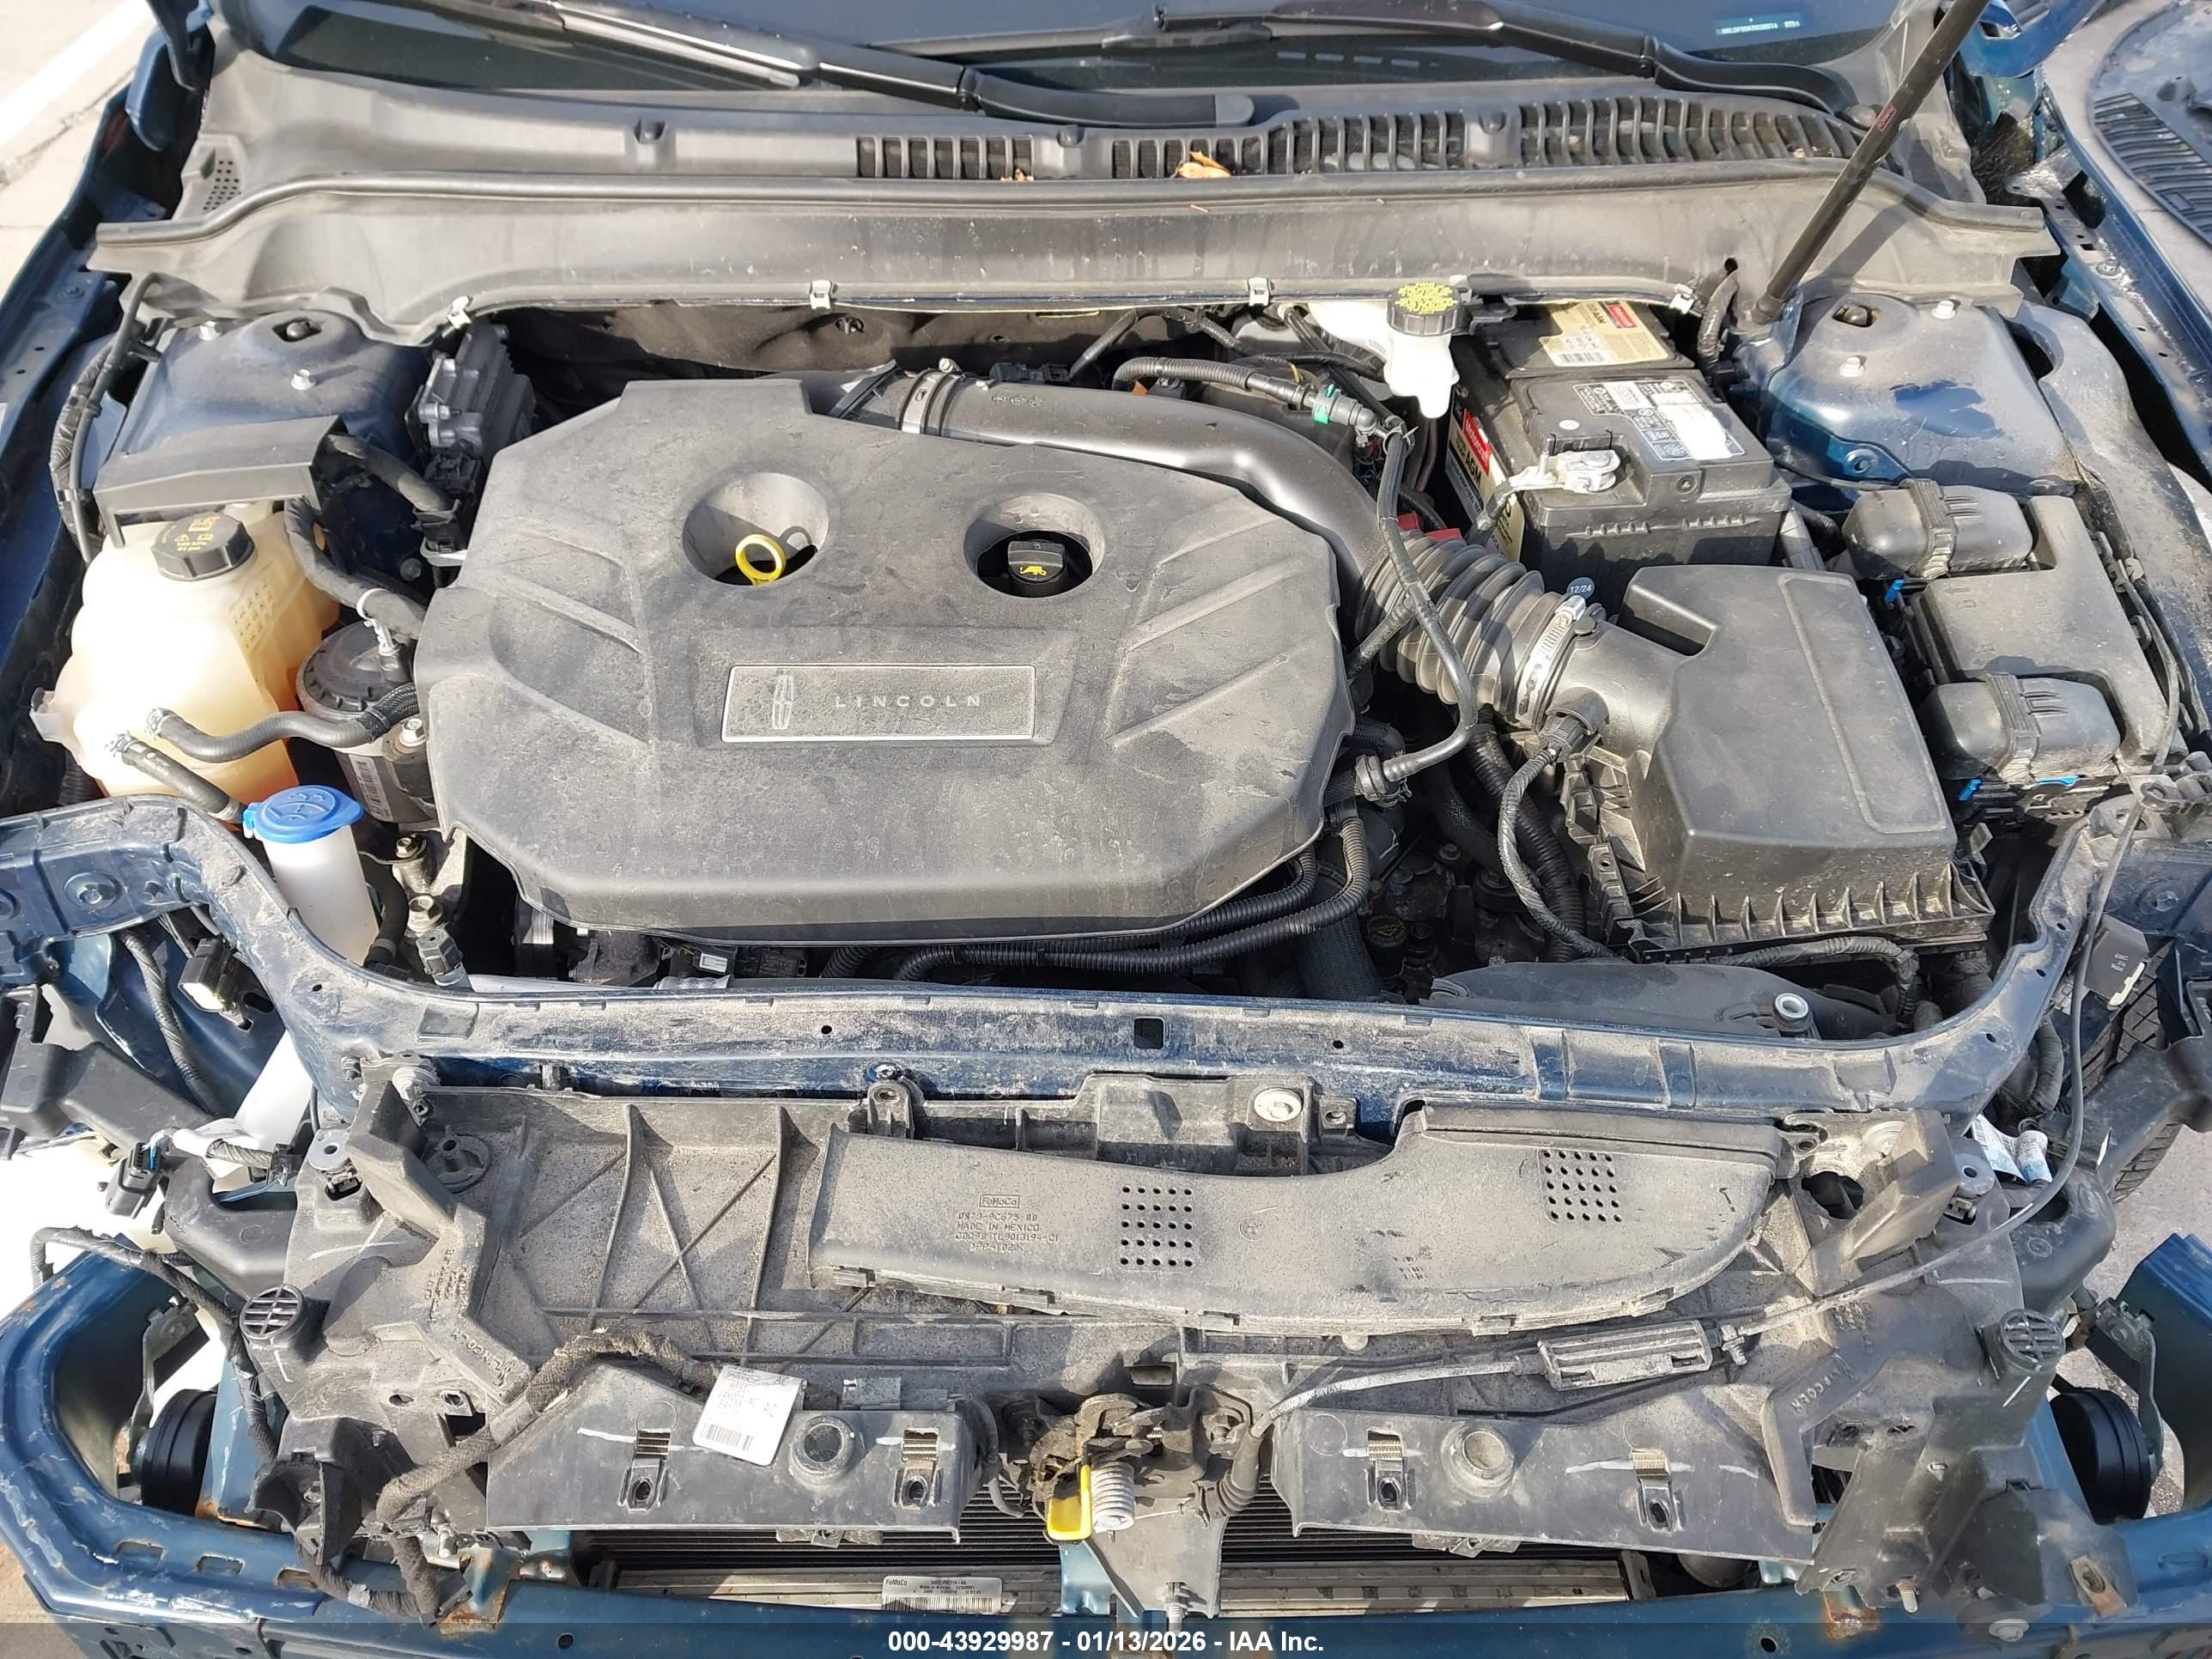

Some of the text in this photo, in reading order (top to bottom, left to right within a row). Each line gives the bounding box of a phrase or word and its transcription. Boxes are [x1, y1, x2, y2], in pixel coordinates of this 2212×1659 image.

[1465, 450, 1482, 489] AGM
[1570, 584, 1593, 594] 12/24
[835, 695, 981, 708] LINCOLN
[981, 1197, 1018, 1206] FoMoCo
[957, 1222, 982, 1231] MADE
